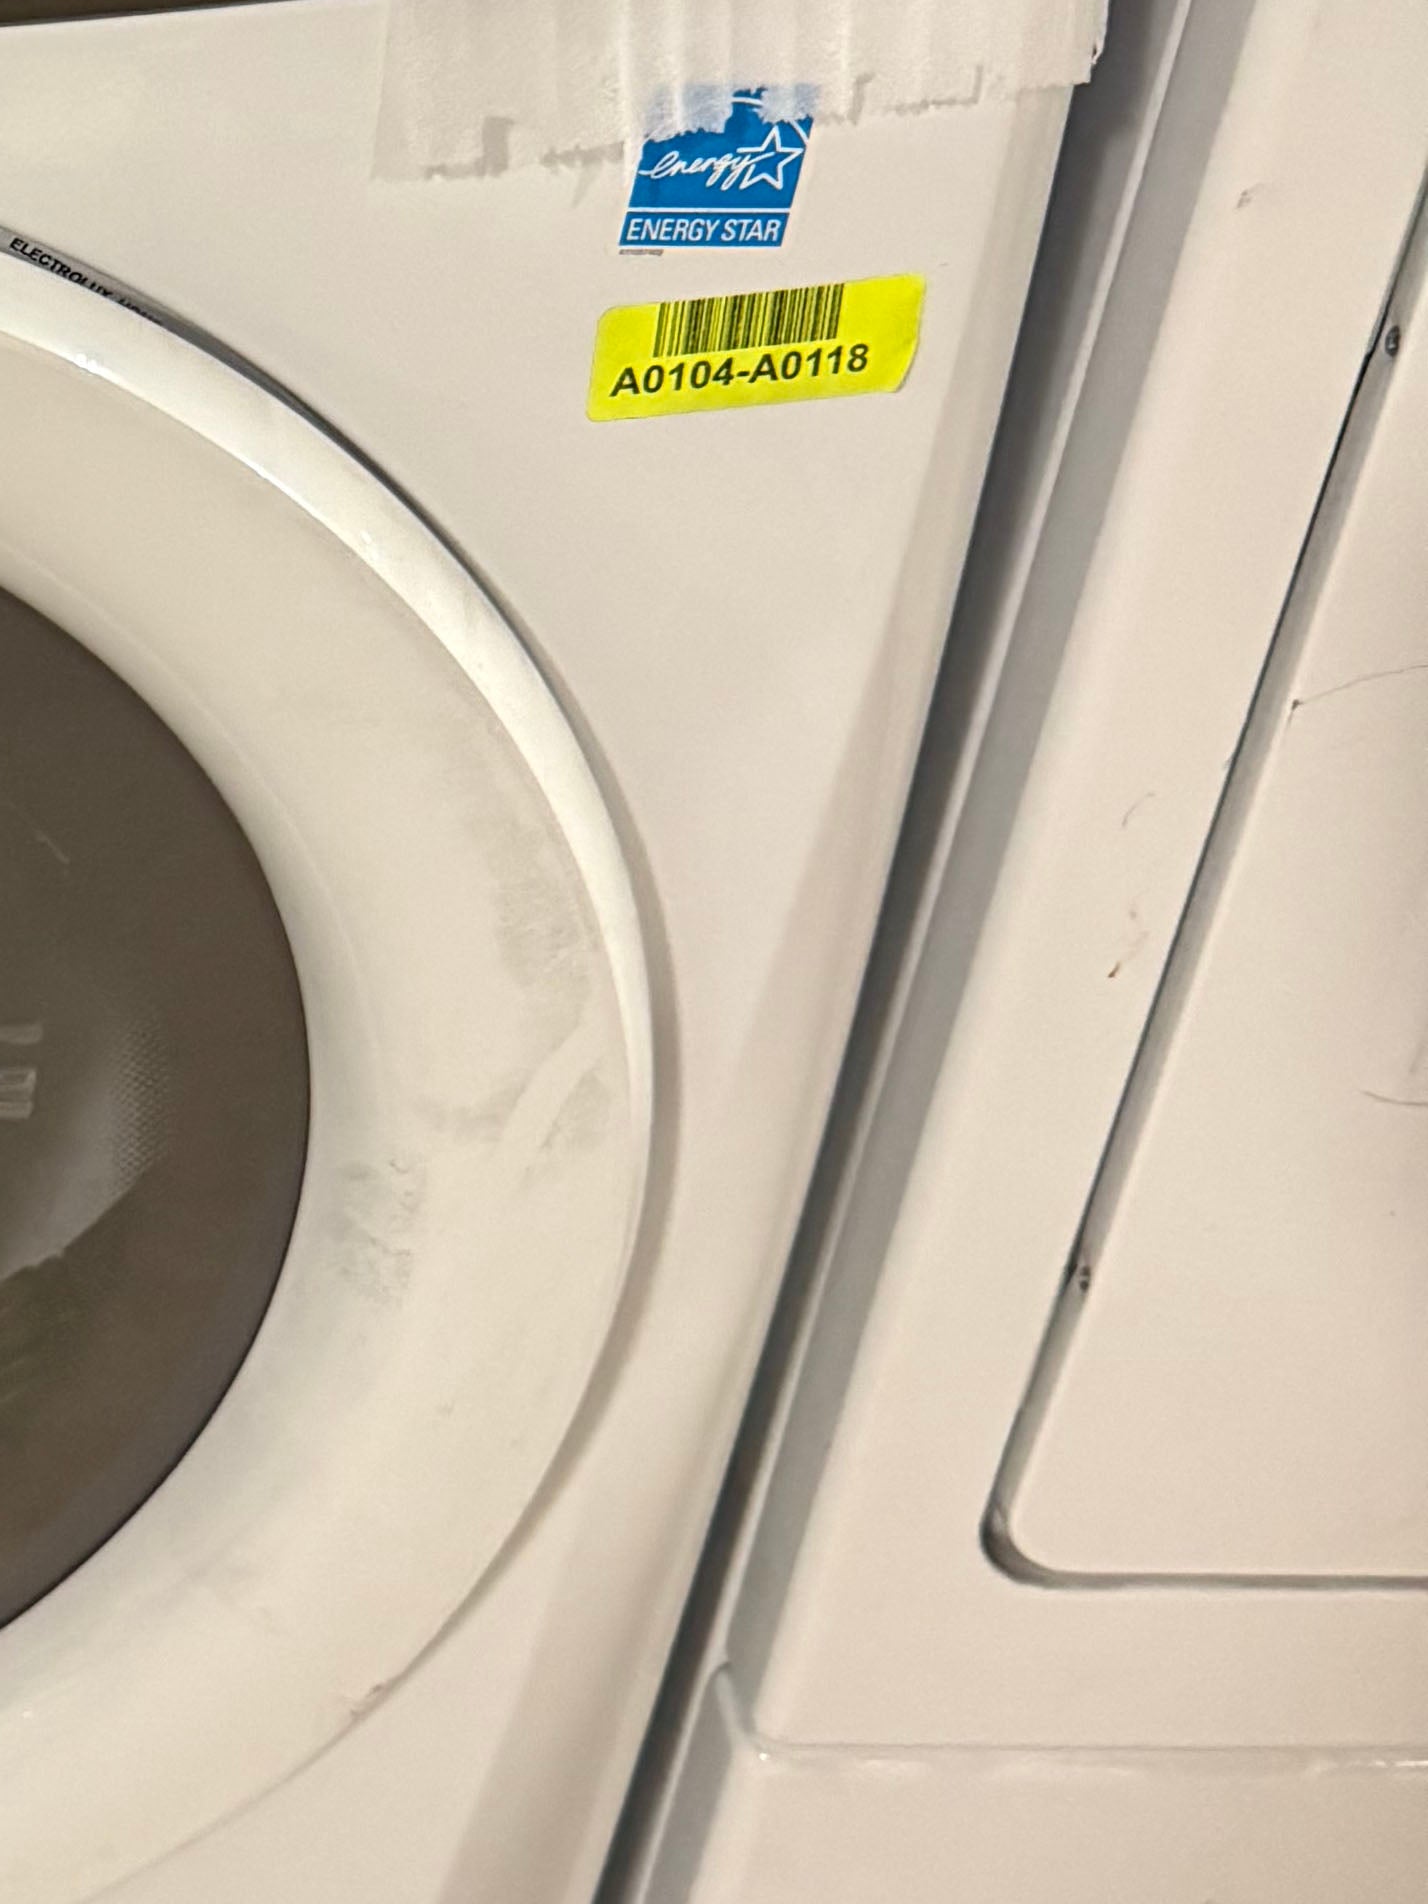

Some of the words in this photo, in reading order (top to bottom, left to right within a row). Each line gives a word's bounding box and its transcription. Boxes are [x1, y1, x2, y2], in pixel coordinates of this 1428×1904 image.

[639, 149, 776, 191] energy
[626, 218, 717, 242] ENERGY
[720, 218, 783, 243] STAR
[9, 237, 114, 298] ELECTROLUX
[610, 343, 870, 398] A0104-A0118
